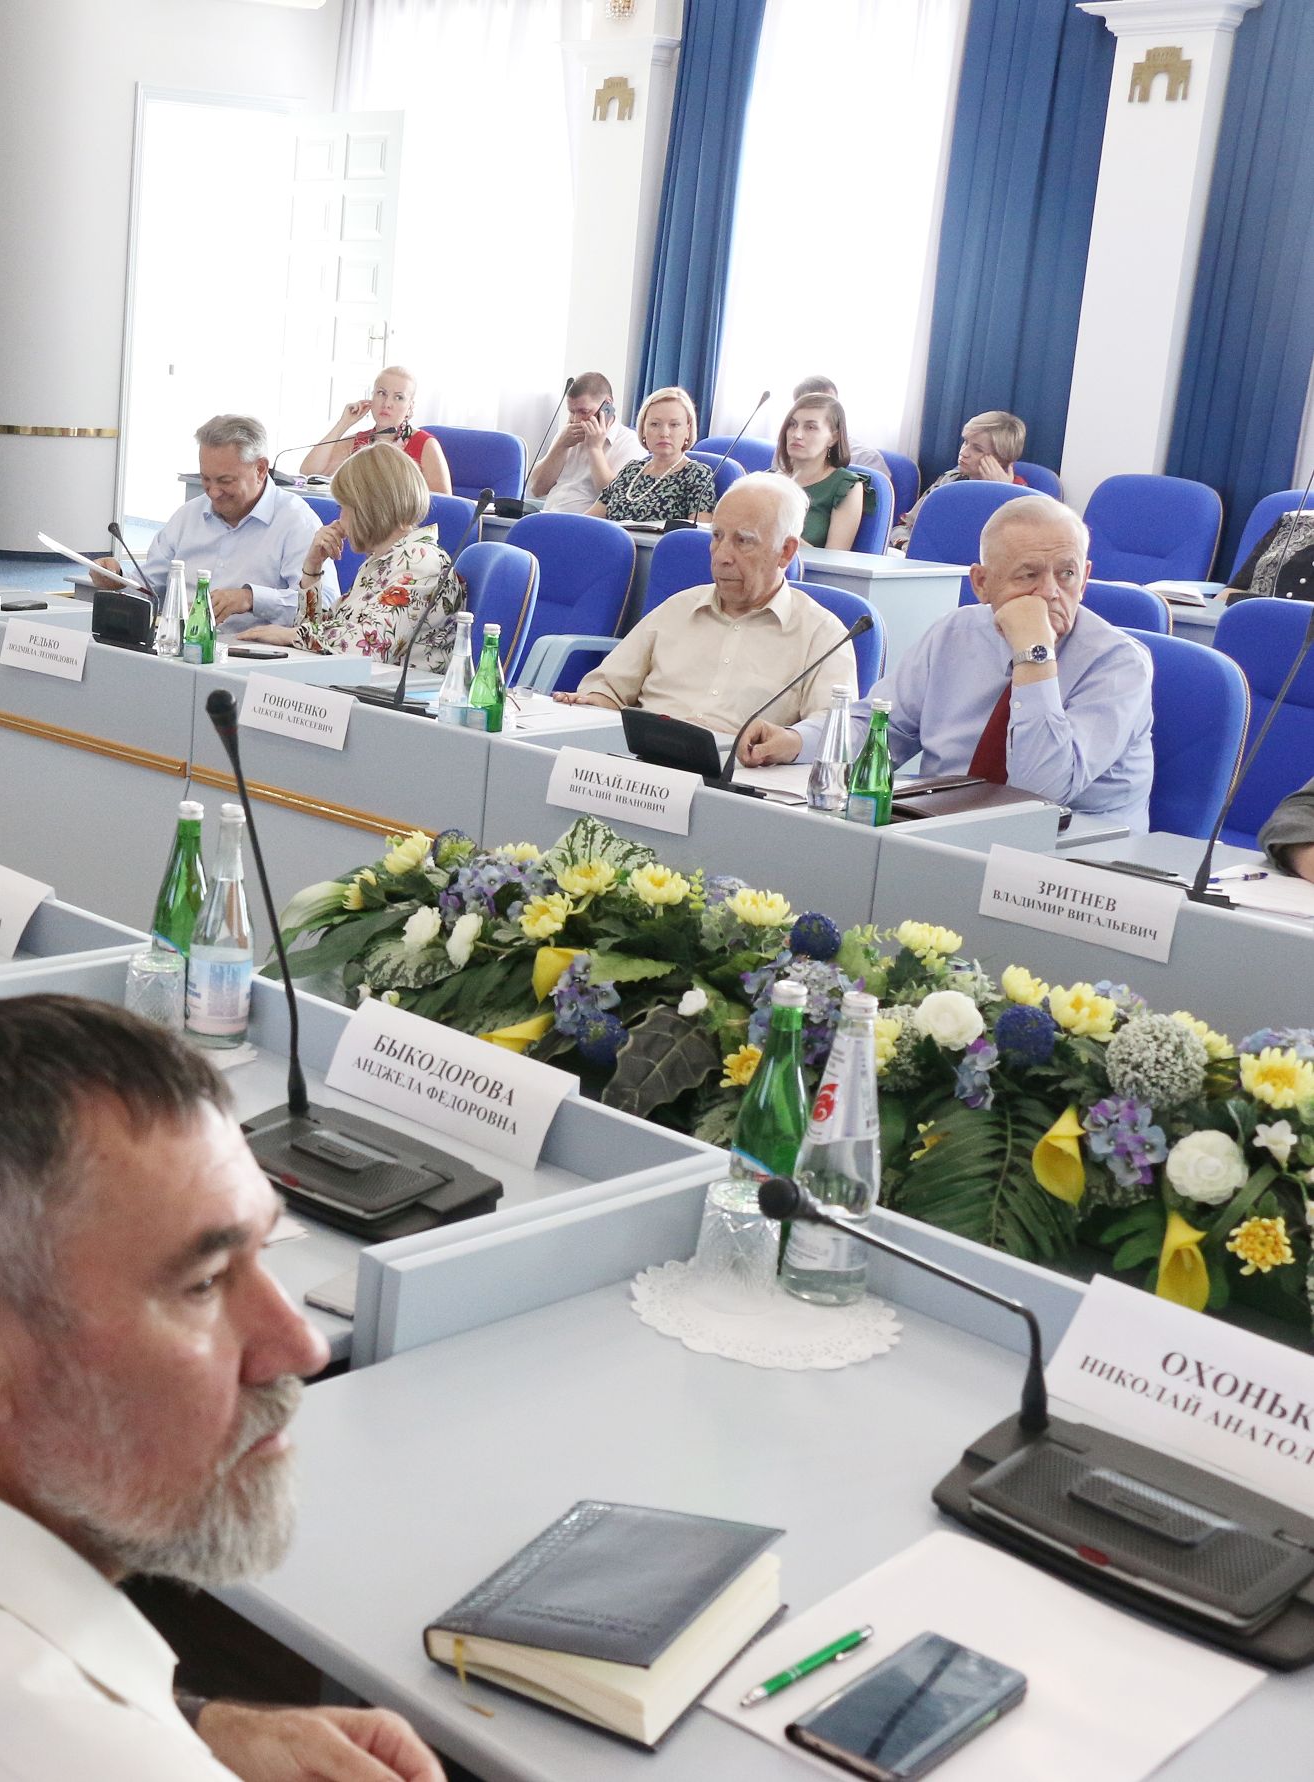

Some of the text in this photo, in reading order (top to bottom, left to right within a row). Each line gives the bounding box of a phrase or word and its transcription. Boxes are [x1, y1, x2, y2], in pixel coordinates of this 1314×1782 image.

[7, 643, 78, 666] ЛЮДМИЛА ЛЕОНИДОВНА
[29, 634, 60, 650] РЕДЬКО
[253, 705, 333, 734] АЛЕКСЕЙ АЛЕКСЕЕВИЧ
[262, 692, 328, 719] ГОНОЧЕНКО
[569, 783, 666, 814] ВИТАЛИЙ ИВАНОВИЧ
[572, 767, 670, 800] МИХАЙЛЕНКО
[1037, 880, 1117, 912] ЗРИТНЕВ
[992, 889, 1158, 941] ВЛАДИМИР ВИТАЛЬЕВИЧ
[373, 1034, 516, 1107] БЫКОДОРОВА
[352, 1055, 518, 1135] АНДЖЕЛА ФЕДОРОВНА
[1161, 1351, 1314, 1431] ОХОНЬК
[1078, 1354, 1314, 1465] НИКОЛАЙ АНАТОЛ
